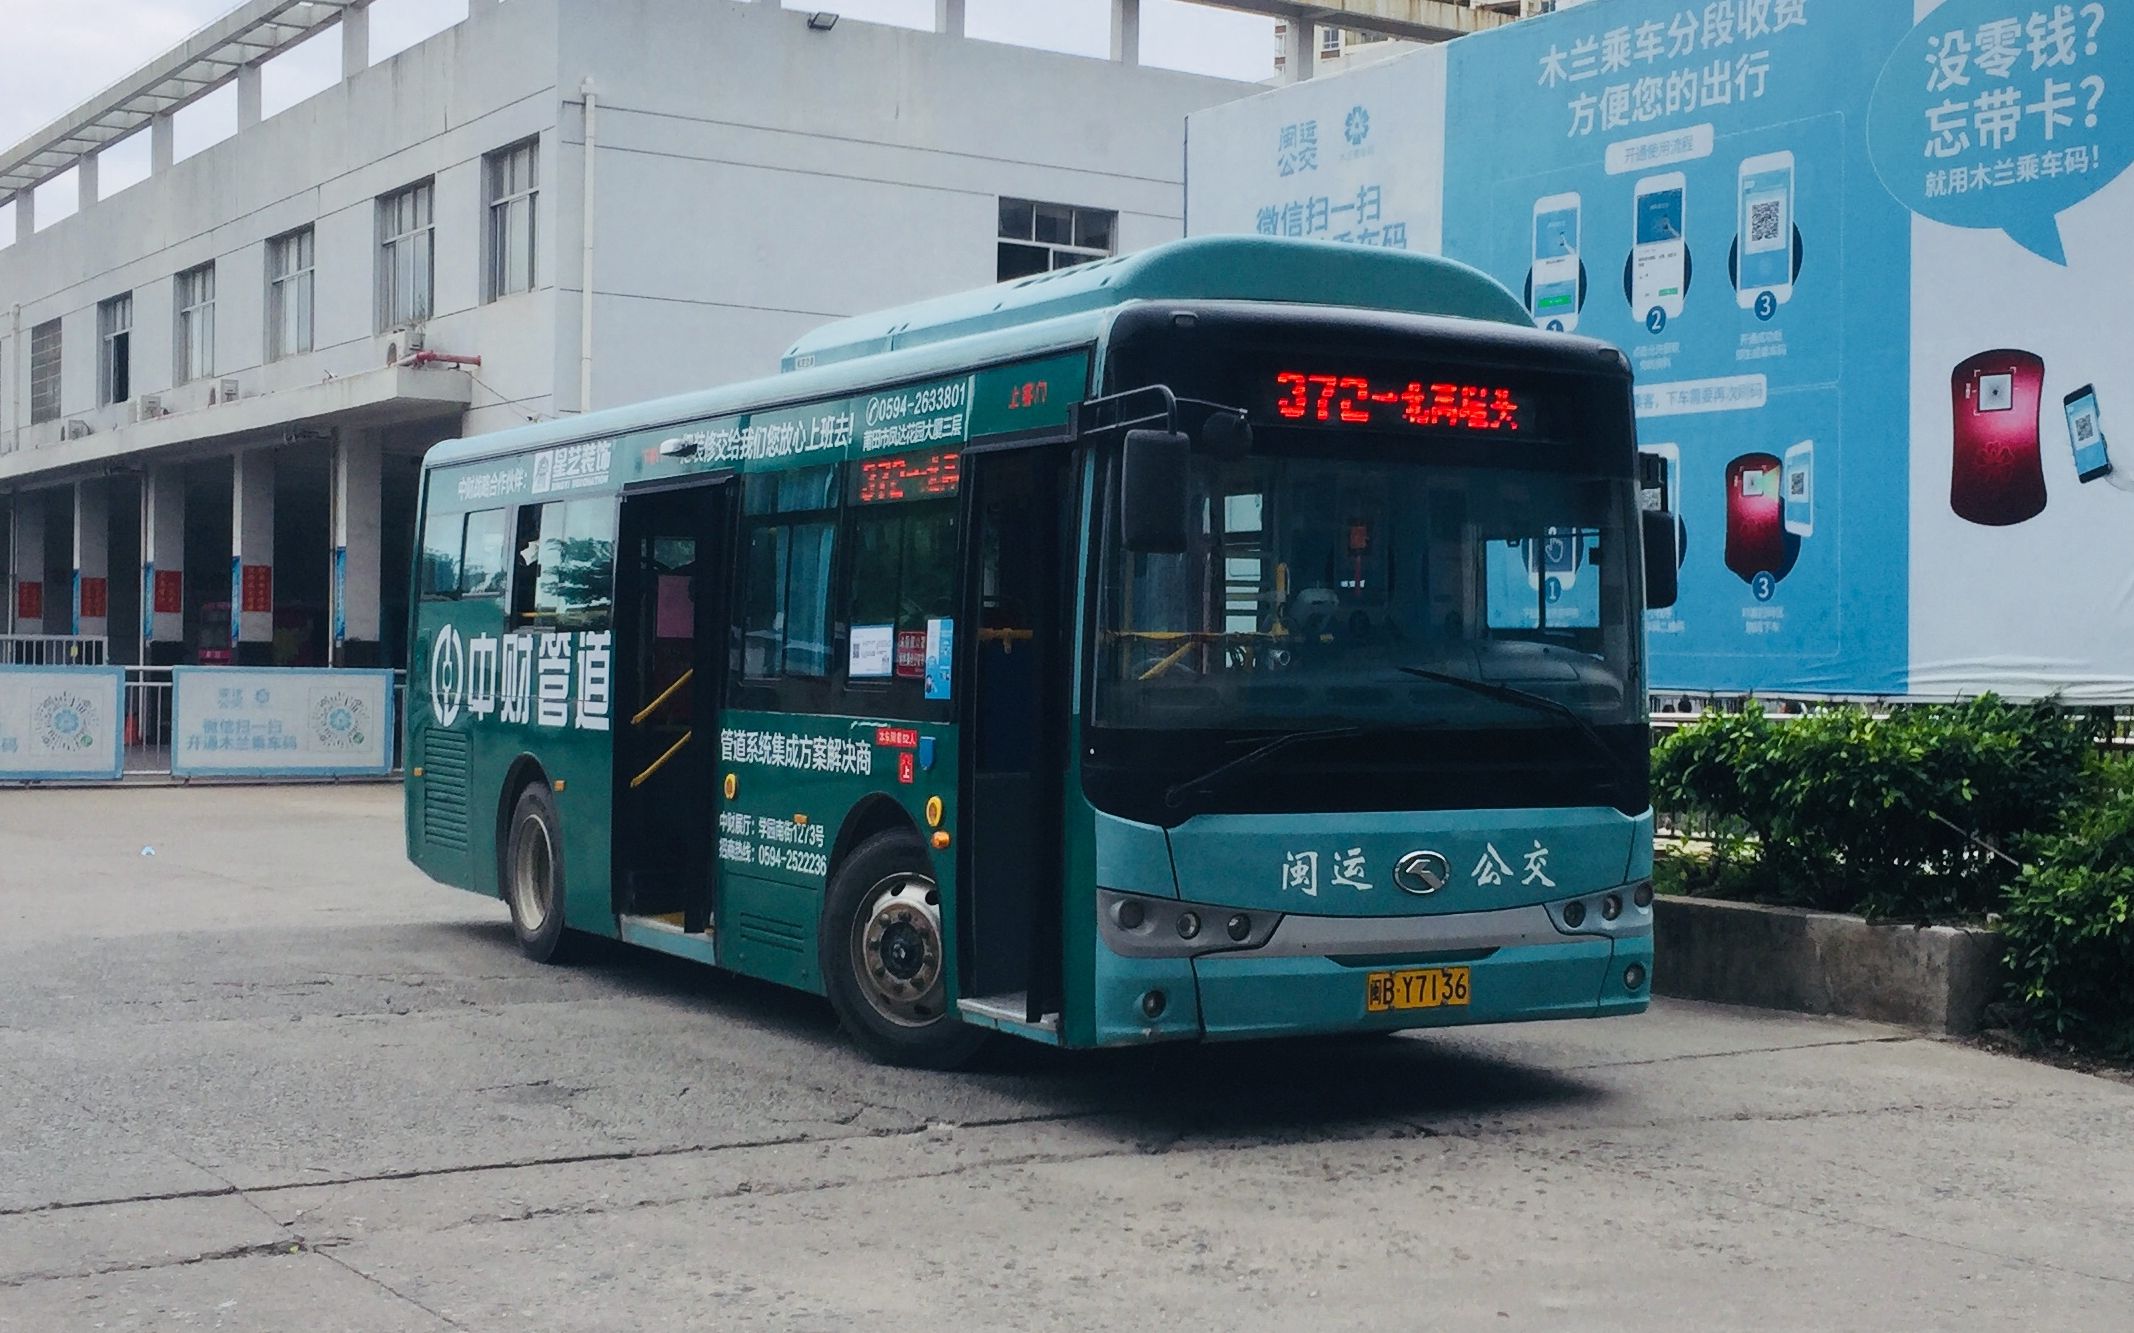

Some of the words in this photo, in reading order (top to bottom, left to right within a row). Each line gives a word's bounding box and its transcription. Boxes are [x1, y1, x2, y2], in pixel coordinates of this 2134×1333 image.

[1538, 0, 1807, 88] 木兰乘车分段收费
[1925, 2, 2105, 92] 没零钱？
[1567, 50, 1770, 138] 方便您的出行
[1924, 75, 2105, 158] 忘带卡？
[1278, 120, 1318, 152] 闽运
[1278, 147, 1318, 177] 公交
[1925, 145, 2099, 197] 就用木兰乘车码！
[1256, 185, 1381, 236] 微信扫一扫
[1651, 310, 1661, 330] 2
[1760, 297, 1771, 316] 3
[878, 383, 966, 421] 0594-2633801
[1759, 577, 1769, 598] 3
[467, 630, 612, 731] 中财管道
[720, 728, 872, 776] 管道系统集成方案解决商
[1281, 847, 1374, 897] 闽运
[1471, 840, 1556, 887] 公交
